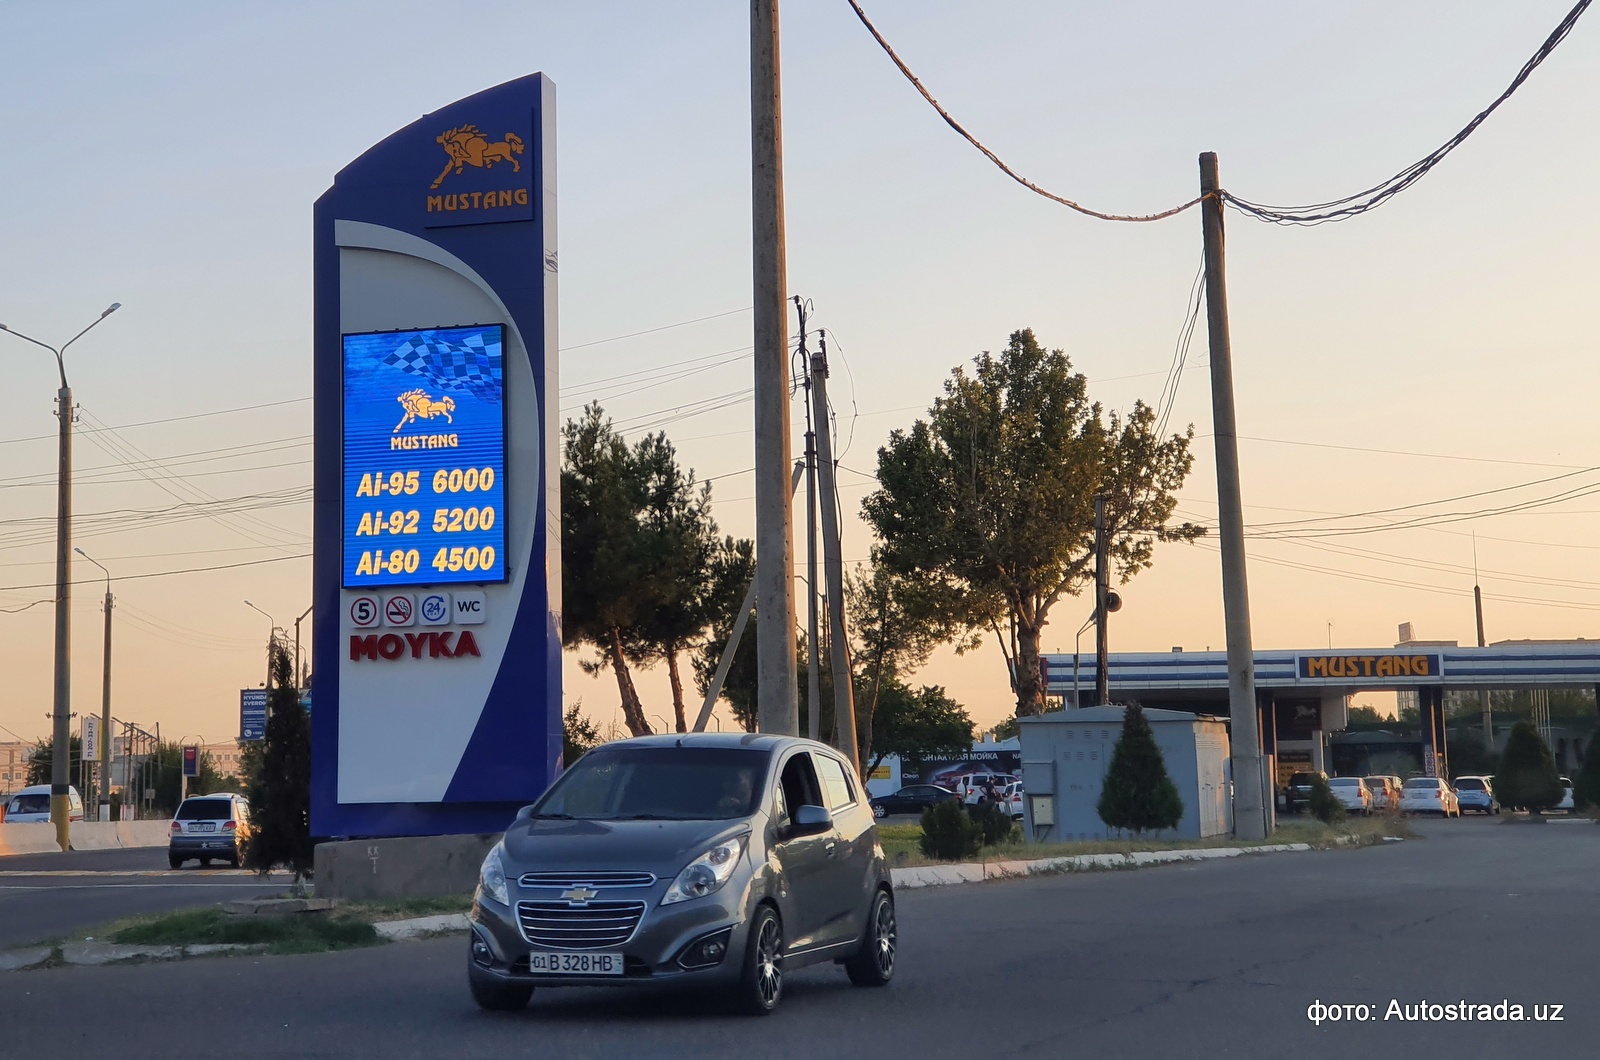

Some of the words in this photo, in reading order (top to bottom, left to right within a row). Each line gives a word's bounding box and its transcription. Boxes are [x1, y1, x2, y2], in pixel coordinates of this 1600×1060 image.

[427, 188, 528, 212] MUSTANG
[390, 433, 459, 451] MUSTANG
[355, 470, 420, 498] Ai-95
[432, 467, 495, 494] 6000
[355, 509, 420, 537] Ai-92
[432, 506, 495, 533] 5200
[355, 549, 420, 576] Ai-80
[431, 546, 496, 572] 4500
[357, 602, 370, 620] 5
[427, 602, 440, 613] 24
[457, 601, 480, 613] WC
[350, 631, 481, 661] MOYKA
[1307, 655, 1429, 678] MUSTANG
[970, 751, 999, 761] МОЙКА
[533, 956, 547, 969] 01
